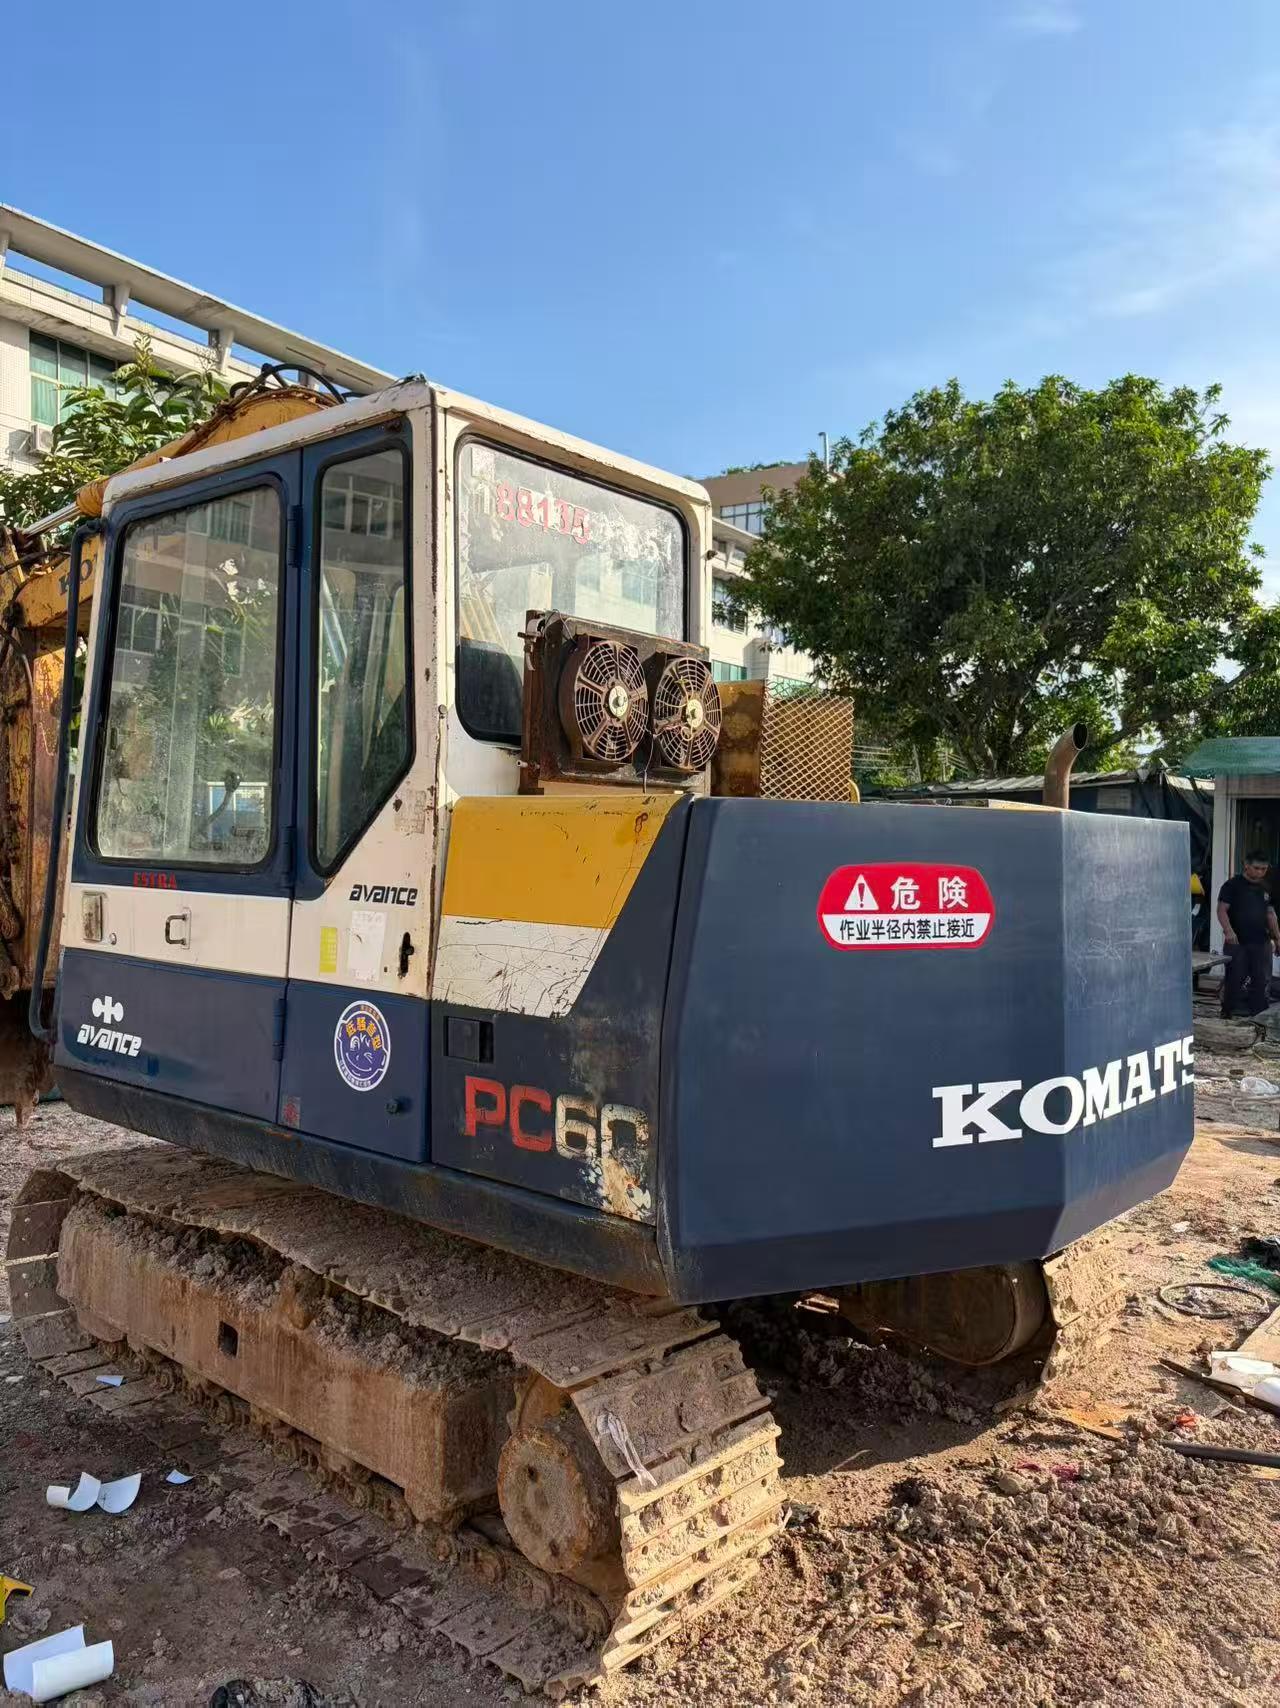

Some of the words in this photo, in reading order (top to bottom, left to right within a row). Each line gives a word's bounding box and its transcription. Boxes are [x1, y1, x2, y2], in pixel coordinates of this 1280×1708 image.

[349, 884, 418, 906] avance
[840, 918, 975, 941] 作业半径内禁止接近
[77, 1023, 142, 1057] avance
